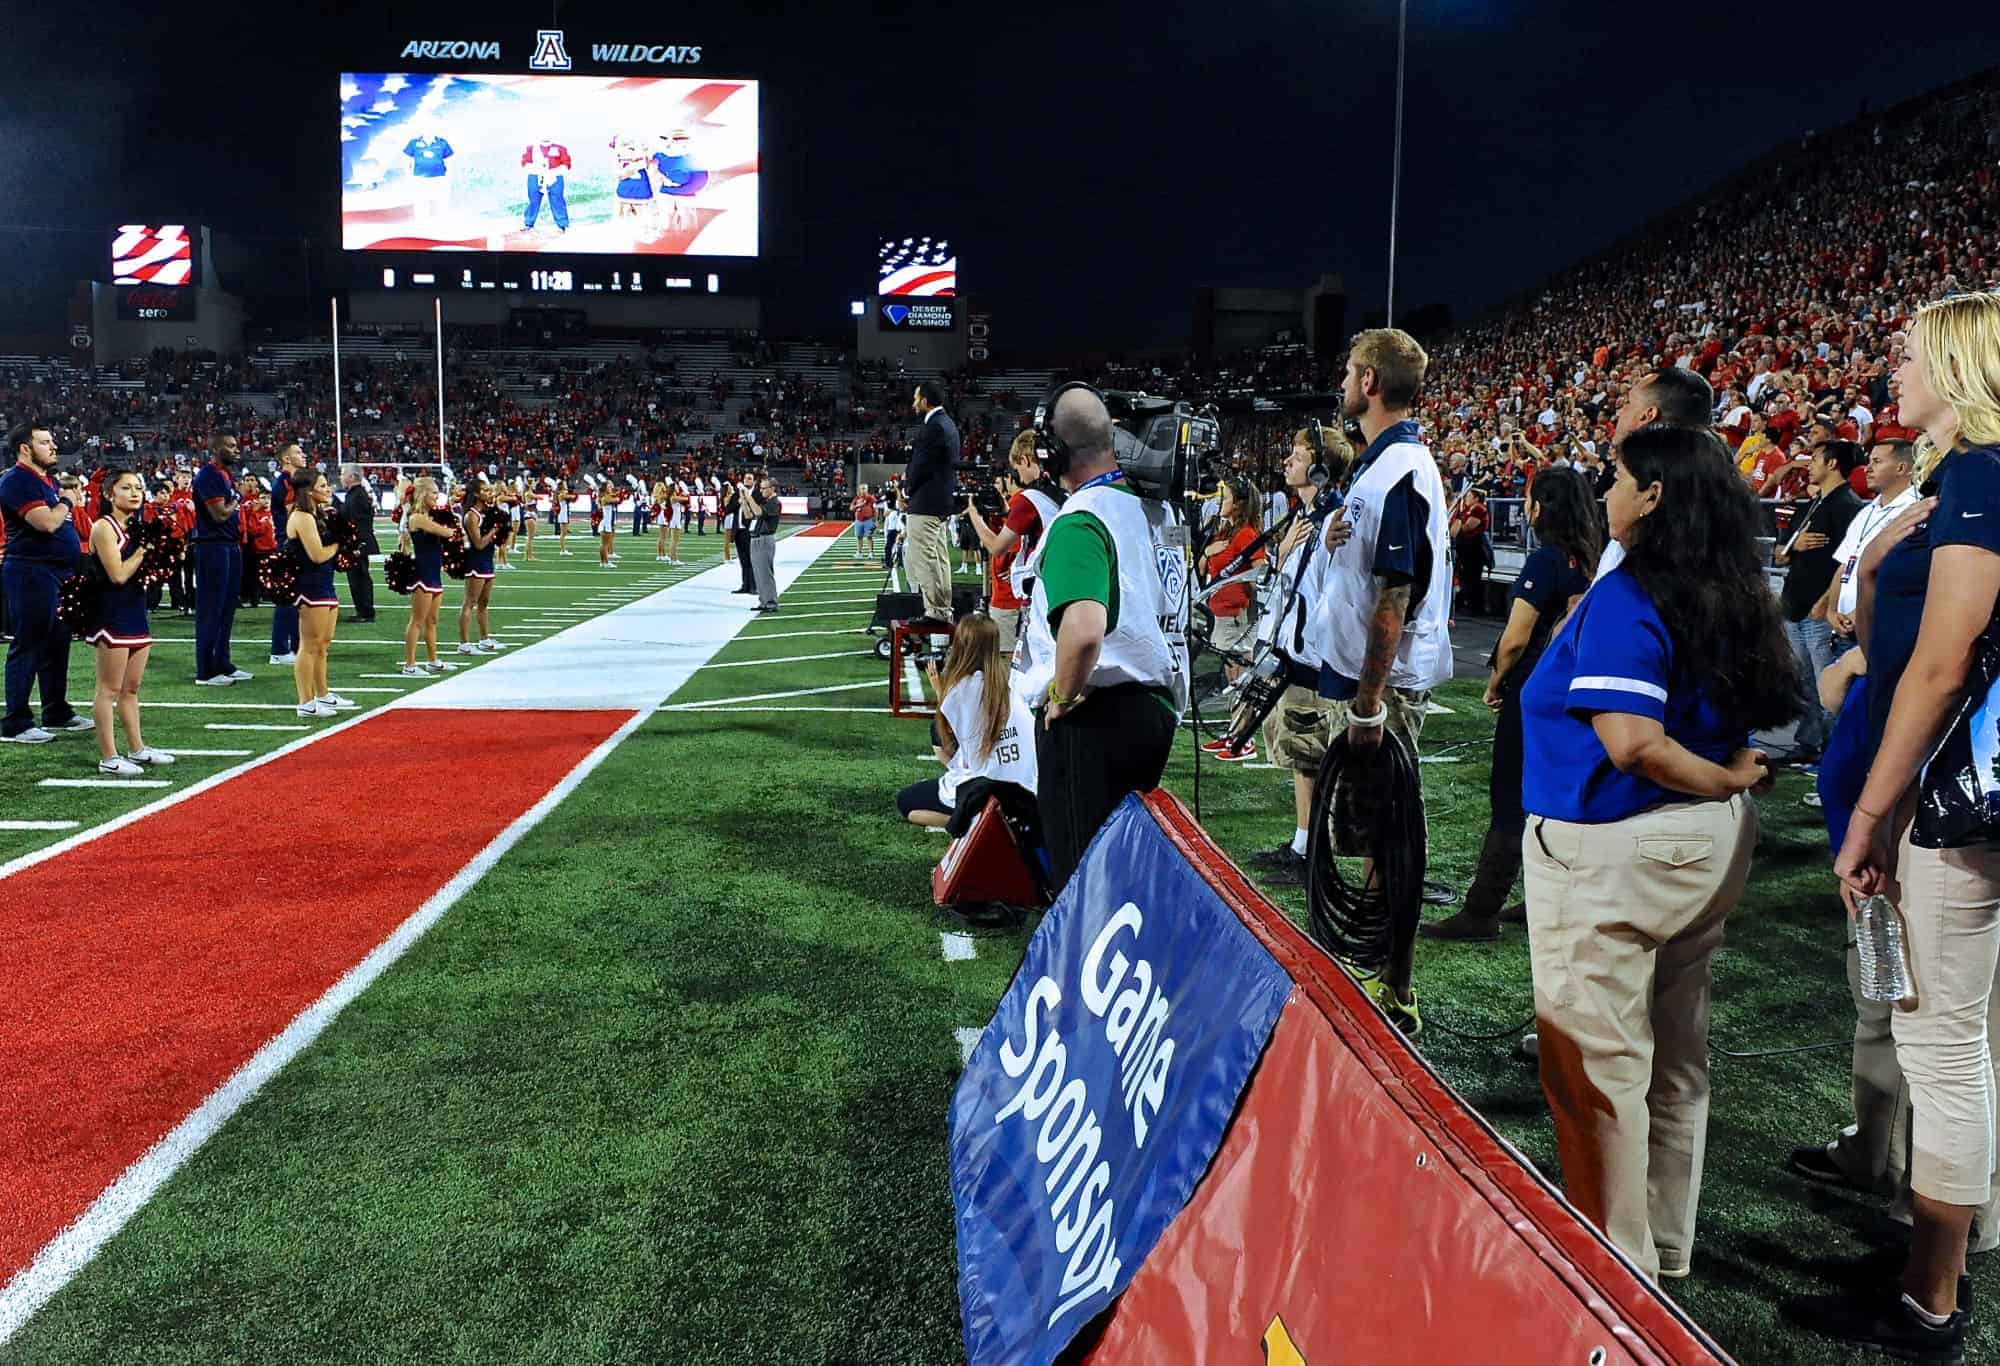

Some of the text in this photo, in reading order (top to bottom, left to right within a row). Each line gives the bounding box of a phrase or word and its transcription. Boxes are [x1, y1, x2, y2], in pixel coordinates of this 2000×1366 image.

[400, 40, 702, 64] ARIZONA WILDCATS
[529, 30, 572, 69] A
[138, 309, 168, 318] zero
[999, 726, 1018, 741] EDIA
[995, 743, 1020, 766] 159
[1080, 901, 1177, 1149] Game
[995, 975, 1123, 1331] Sponsor
